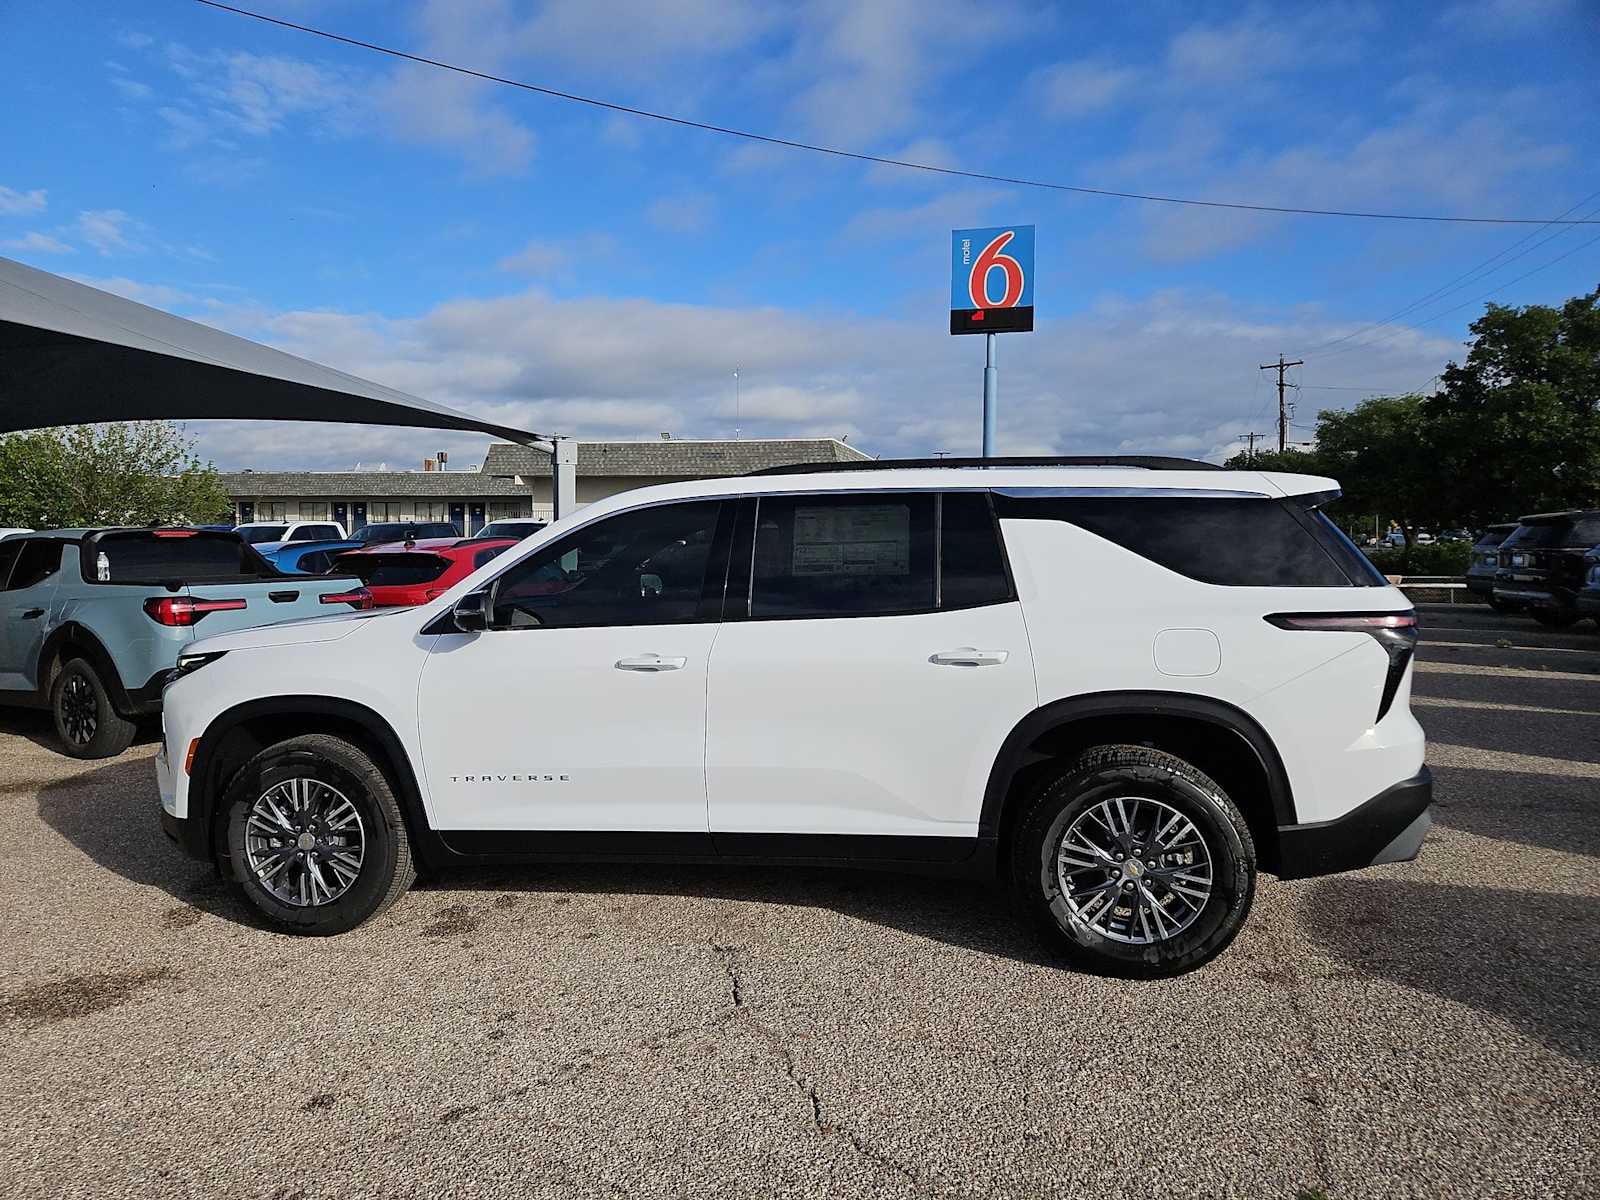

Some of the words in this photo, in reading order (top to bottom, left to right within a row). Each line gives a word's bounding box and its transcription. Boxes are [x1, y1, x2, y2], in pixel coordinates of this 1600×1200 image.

[962, 239, 971, 265] motel
[968, 231, 1025, 309] 6
[449, 775, 571, 783] TRAVERSE
